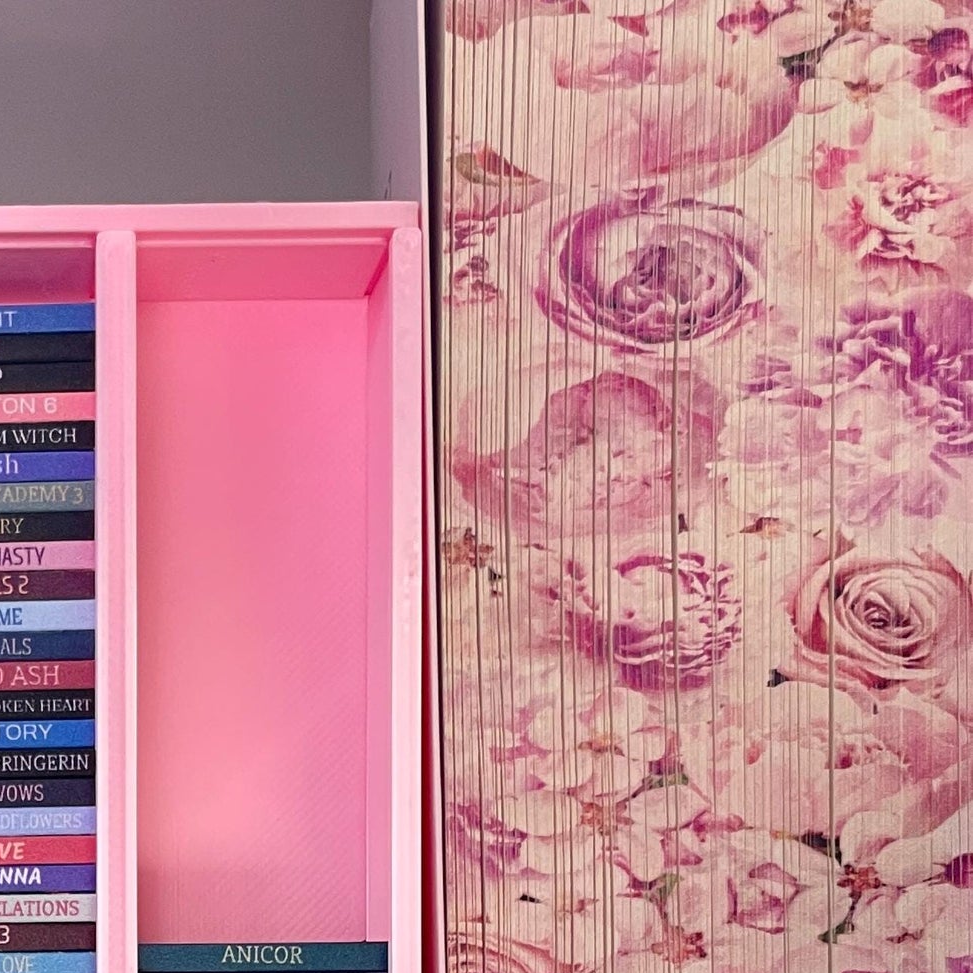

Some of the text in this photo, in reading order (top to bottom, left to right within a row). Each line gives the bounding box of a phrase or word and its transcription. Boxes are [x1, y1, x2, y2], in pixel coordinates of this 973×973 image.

[44, 397, 58, 413] 6
[12, 428, 76, 444] WITCH
[19, 576, 29, 594] 2
[11, 665, 60, 685] ASH
[40, 699, 91, 712] HEART
[221, 945, 303, 964] ANICOR
